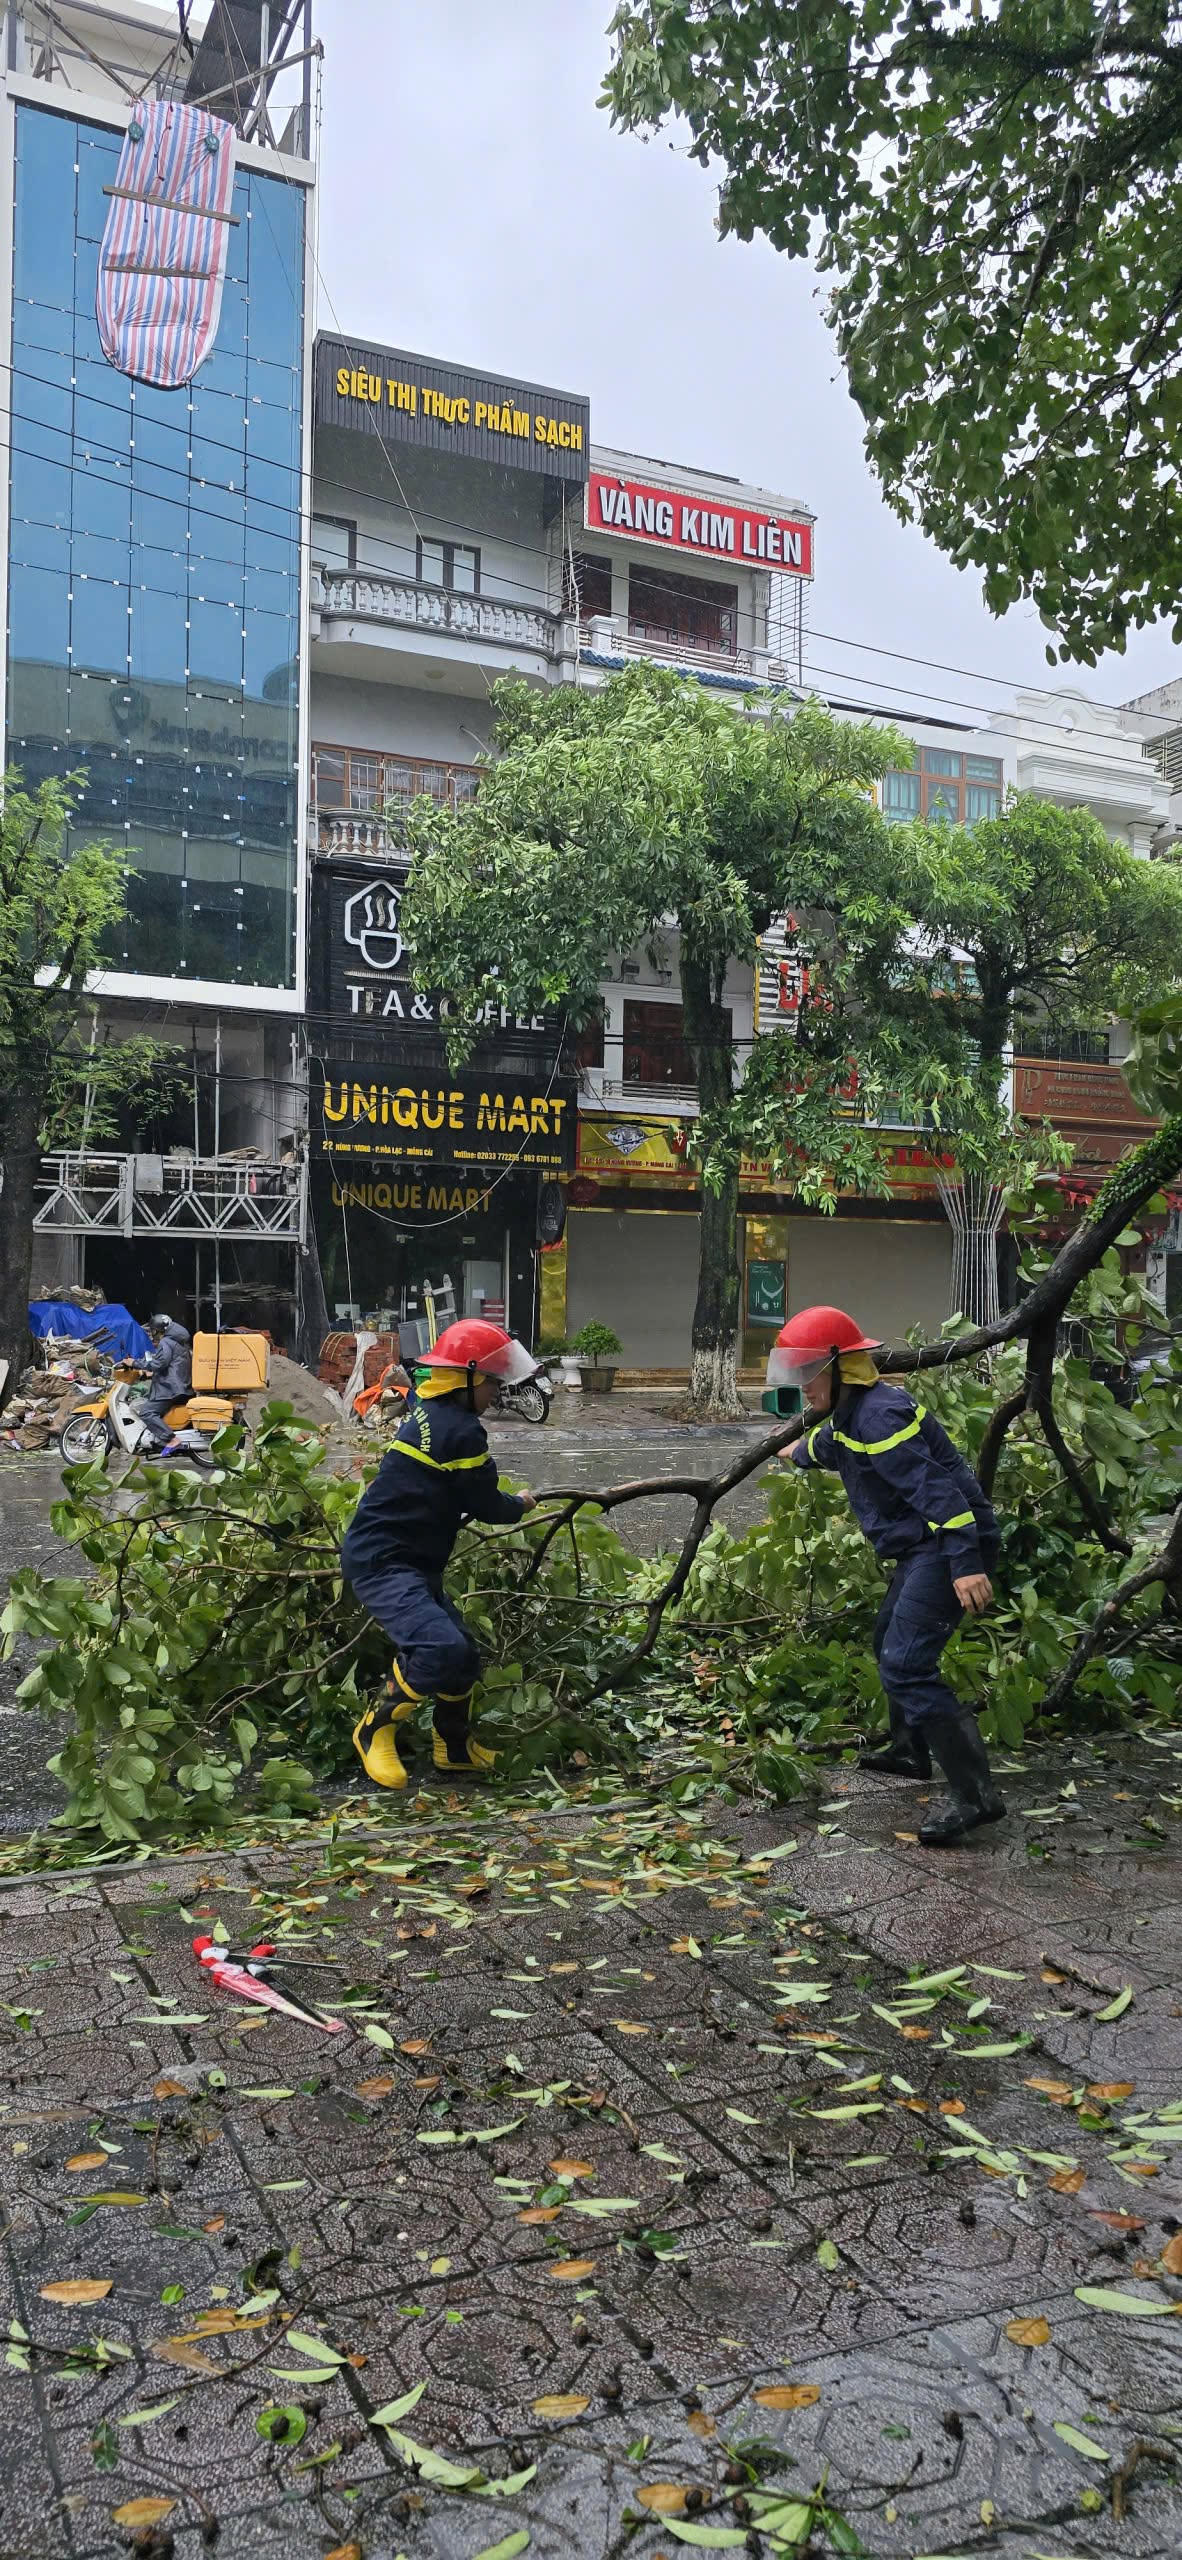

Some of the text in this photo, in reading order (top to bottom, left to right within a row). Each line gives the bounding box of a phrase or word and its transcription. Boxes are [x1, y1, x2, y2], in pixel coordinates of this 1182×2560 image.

[337, 366, 583, 450] SIÊU THỊ THỰC PHẨM SẠCH
[599, 480, 801, 565] VÀNG KIM LIÊN
[346, 985, 405, 1018] TEA
[410, 993, 434, 1020] &
[323, 1081, 567, 1136] UNIQUE MART
[331, 1181, 493, 1213] UNIQUE MART
